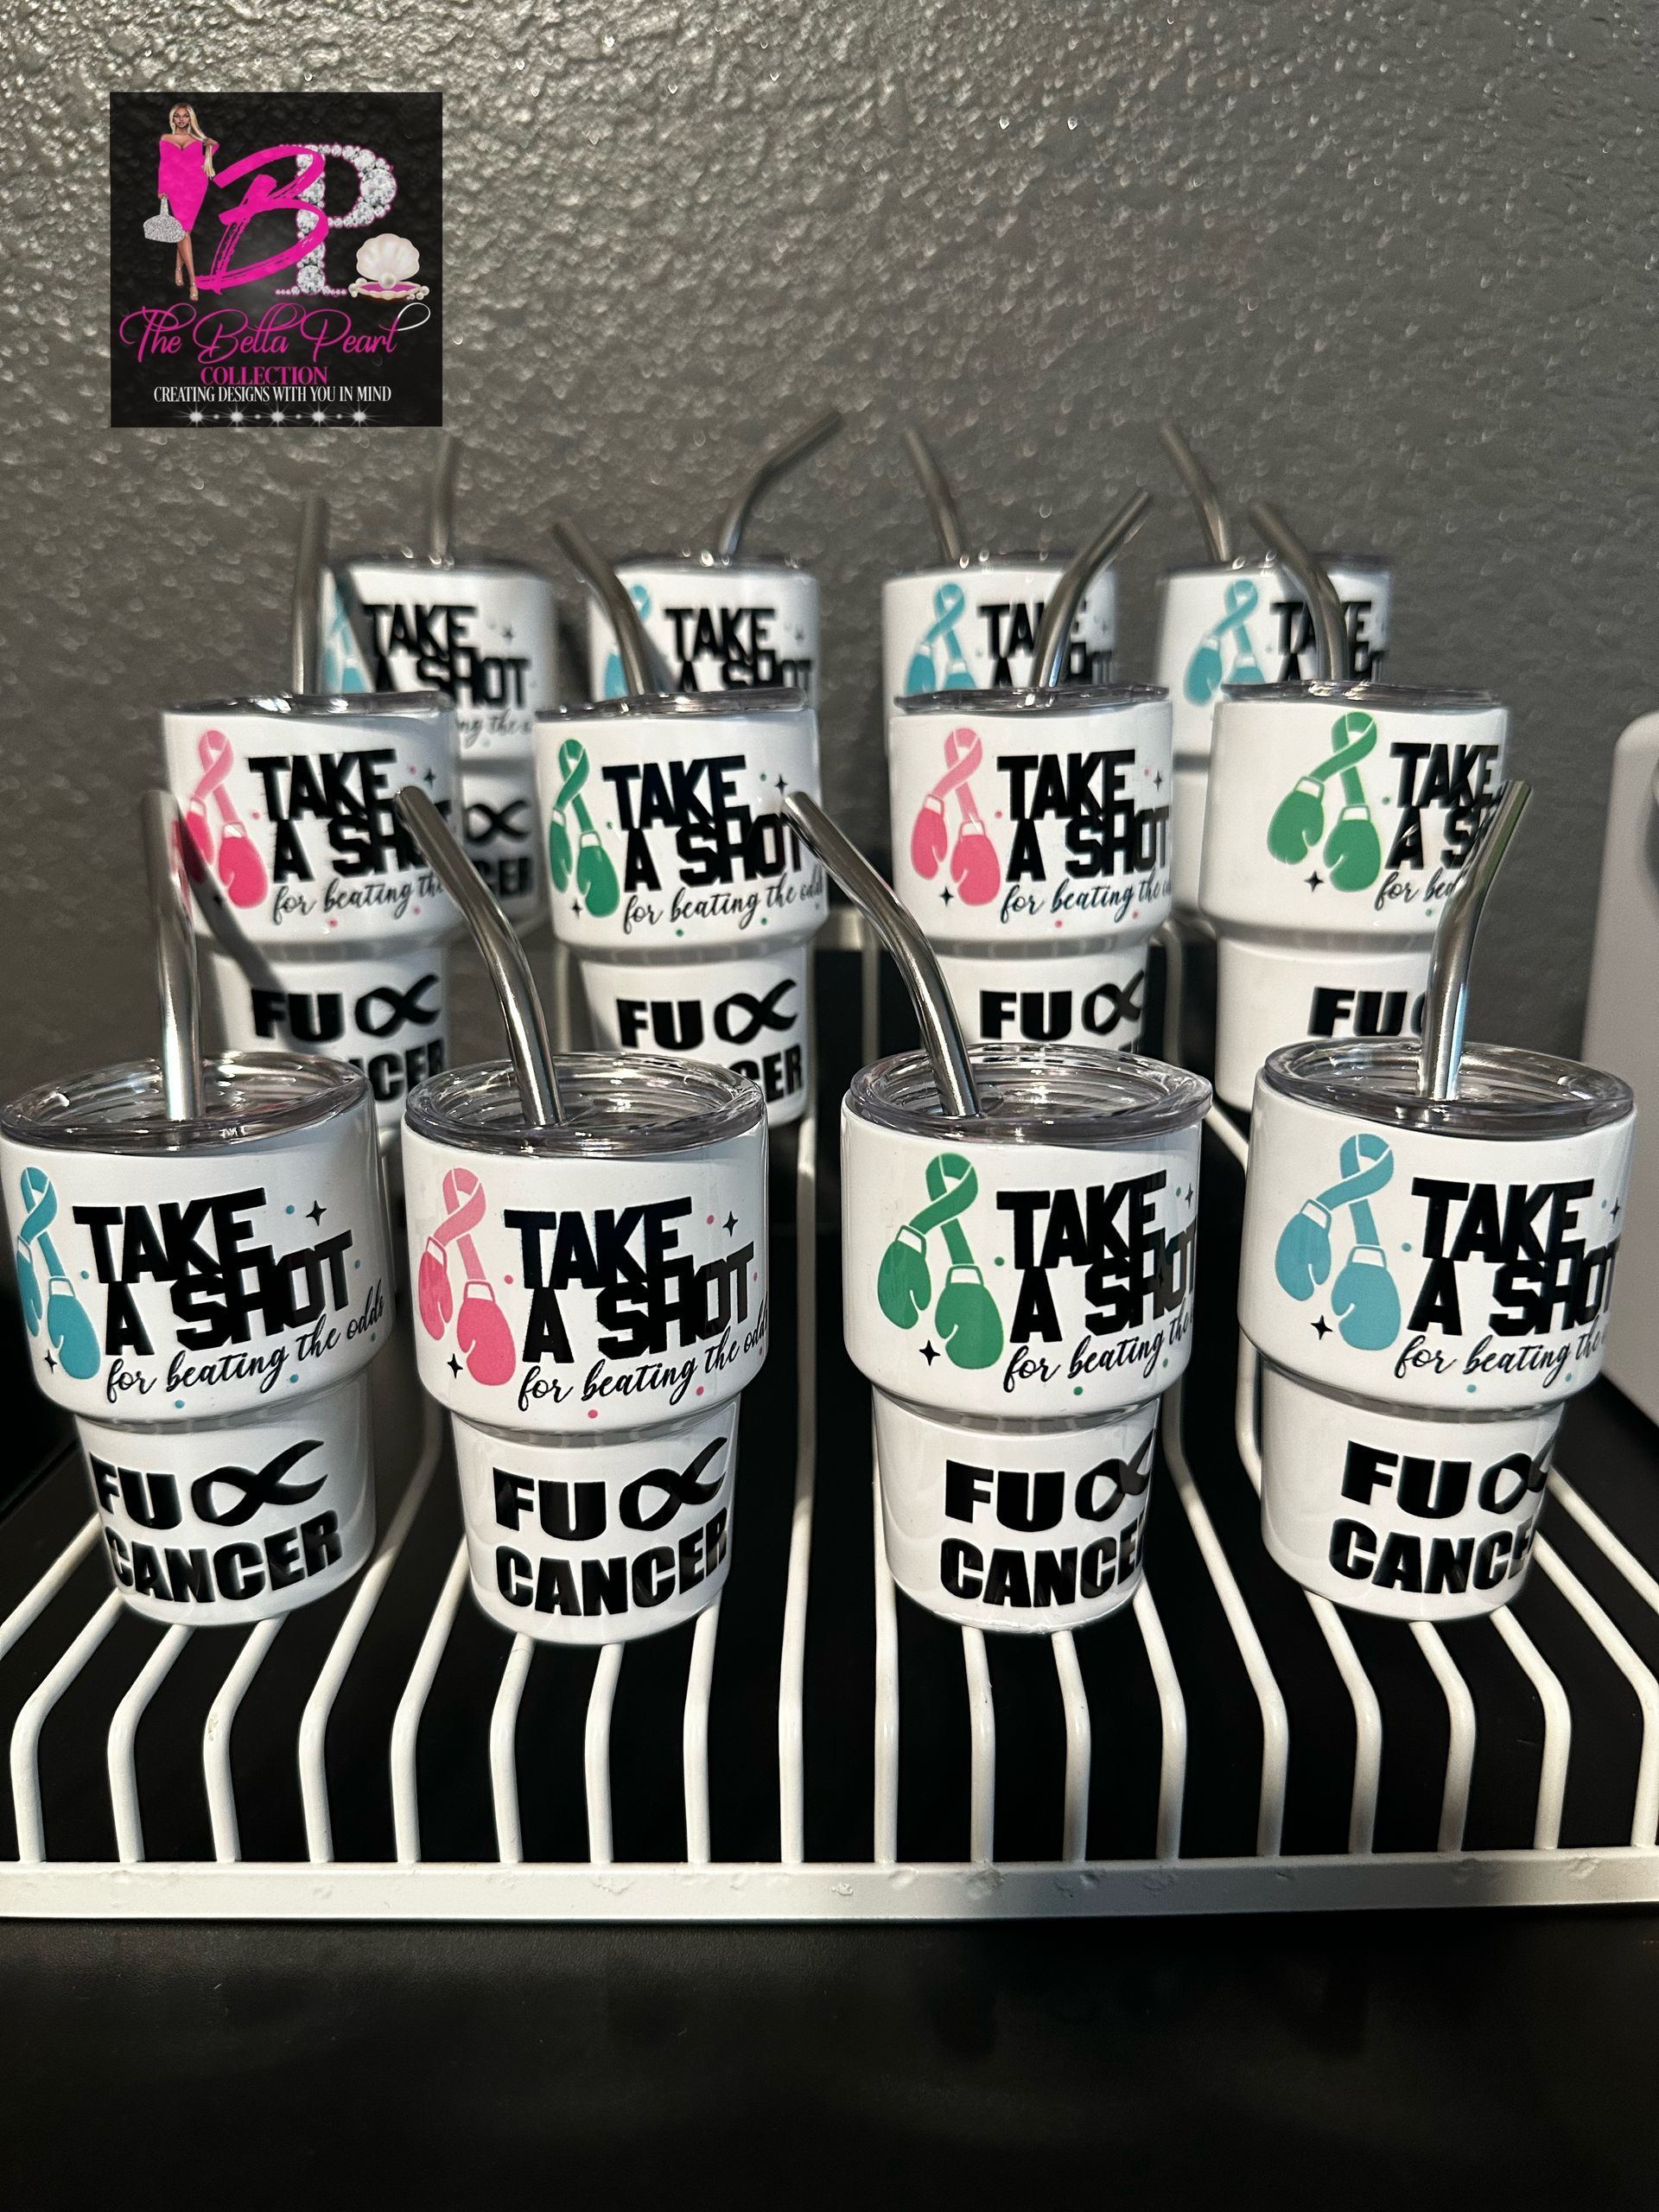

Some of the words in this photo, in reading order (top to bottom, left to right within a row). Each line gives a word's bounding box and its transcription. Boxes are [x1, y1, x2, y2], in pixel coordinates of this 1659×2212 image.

[363, 604, 480, 658] TAKE
[664, 607, 776, 664] TAKE
[976, 601, 1087, 658] TA
[416, 646, 531, 710] SHOT
[247, 747, 397, 822] TAKE
[601, 754, 747, 831] TAKE
[996, 748, 1136, 822] TAKE
[1389, 741, 1499, 810] TAKE
[273, 818, 315, 884] A
[624, 828, 663, 893] A
[1005, 817, 1047, 883] A
[1065, 798, 1170, 880] SHOT
[1384, 806, 1425, 871] A
[273, 883, 318, 925] for
[323, 877, 414, 920] beating
[623, 893, 664, 934] for
[670, 889, 760, 931] beating
[766, 872, 796, 908] the
[1000, 884, 1045, 925] for
[1050, 878, 1135, 923] beating
[1374, 871, 1420, 912] for
[73, 1187, 268, 1285] TAKE
[503, 1196, 693, 1290] TAKE
[996, 1169, 1167, 1269] TAKE
[1411, 1176, 1595, 1263] TAKE
[105, 1281, 156, 1357] A
[169, 1229, 353, 1352] SHOT
[522, 1287, 575, 1364] A
[597, 1240, 755, 1363] SHOT
[1009, 1267, 1063, 1344] A
[1406, 1256, 1463, 1337] A
[106, 1357, 156, 1404] for
[166, 1342, 289, 1394] beating
[296, 1316, 341, 1363] the
[518, 1364, 575, 1414] for
[582, 1356, 697, 1406] beating
[704, 1325, 741, 1374] the
[1001, 1343, 1060, 1395] for
[1067, 1330, 1166, 1379] beating
[1169, 1297, 1189, 1345] the
[1395, 1333, 1458, 1379] for
[1464, 1334, 1571, 1389] beating
[105, 1508, 343, 1604] CANCER
[495, 1504, 728, 1617] CANCER
